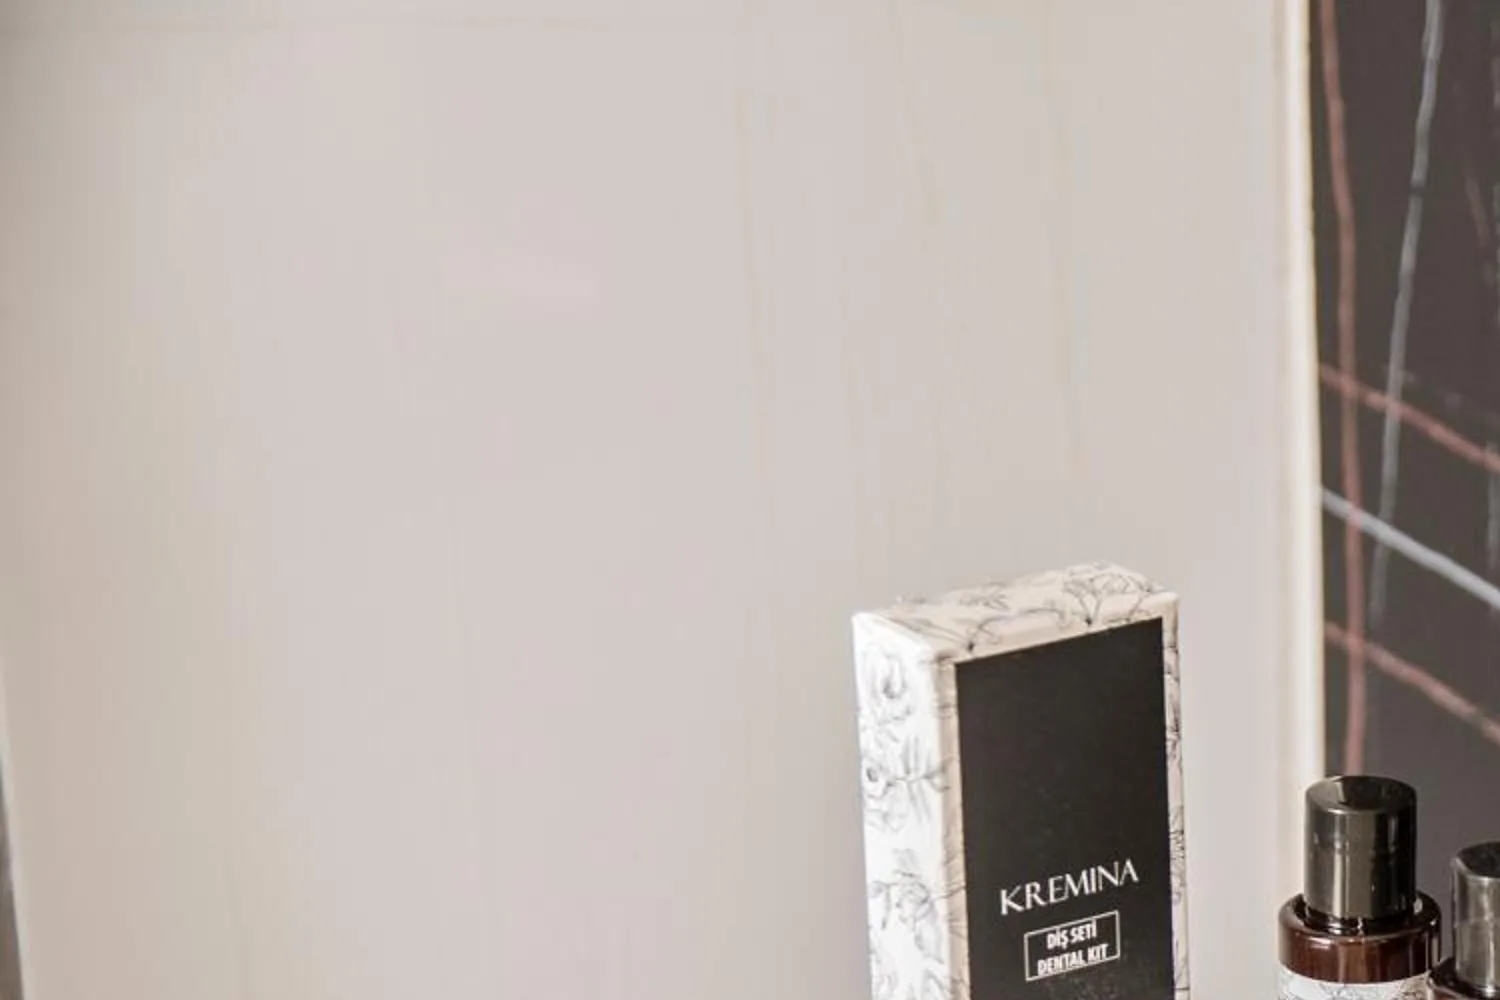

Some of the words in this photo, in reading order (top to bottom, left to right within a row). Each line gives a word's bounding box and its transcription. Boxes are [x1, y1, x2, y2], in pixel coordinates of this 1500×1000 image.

[1000, 858, 1139, 915] KREMINA
[1037, 951, 1086, 977] DENTAL
[1087, 943, 1109, 962] KIT
